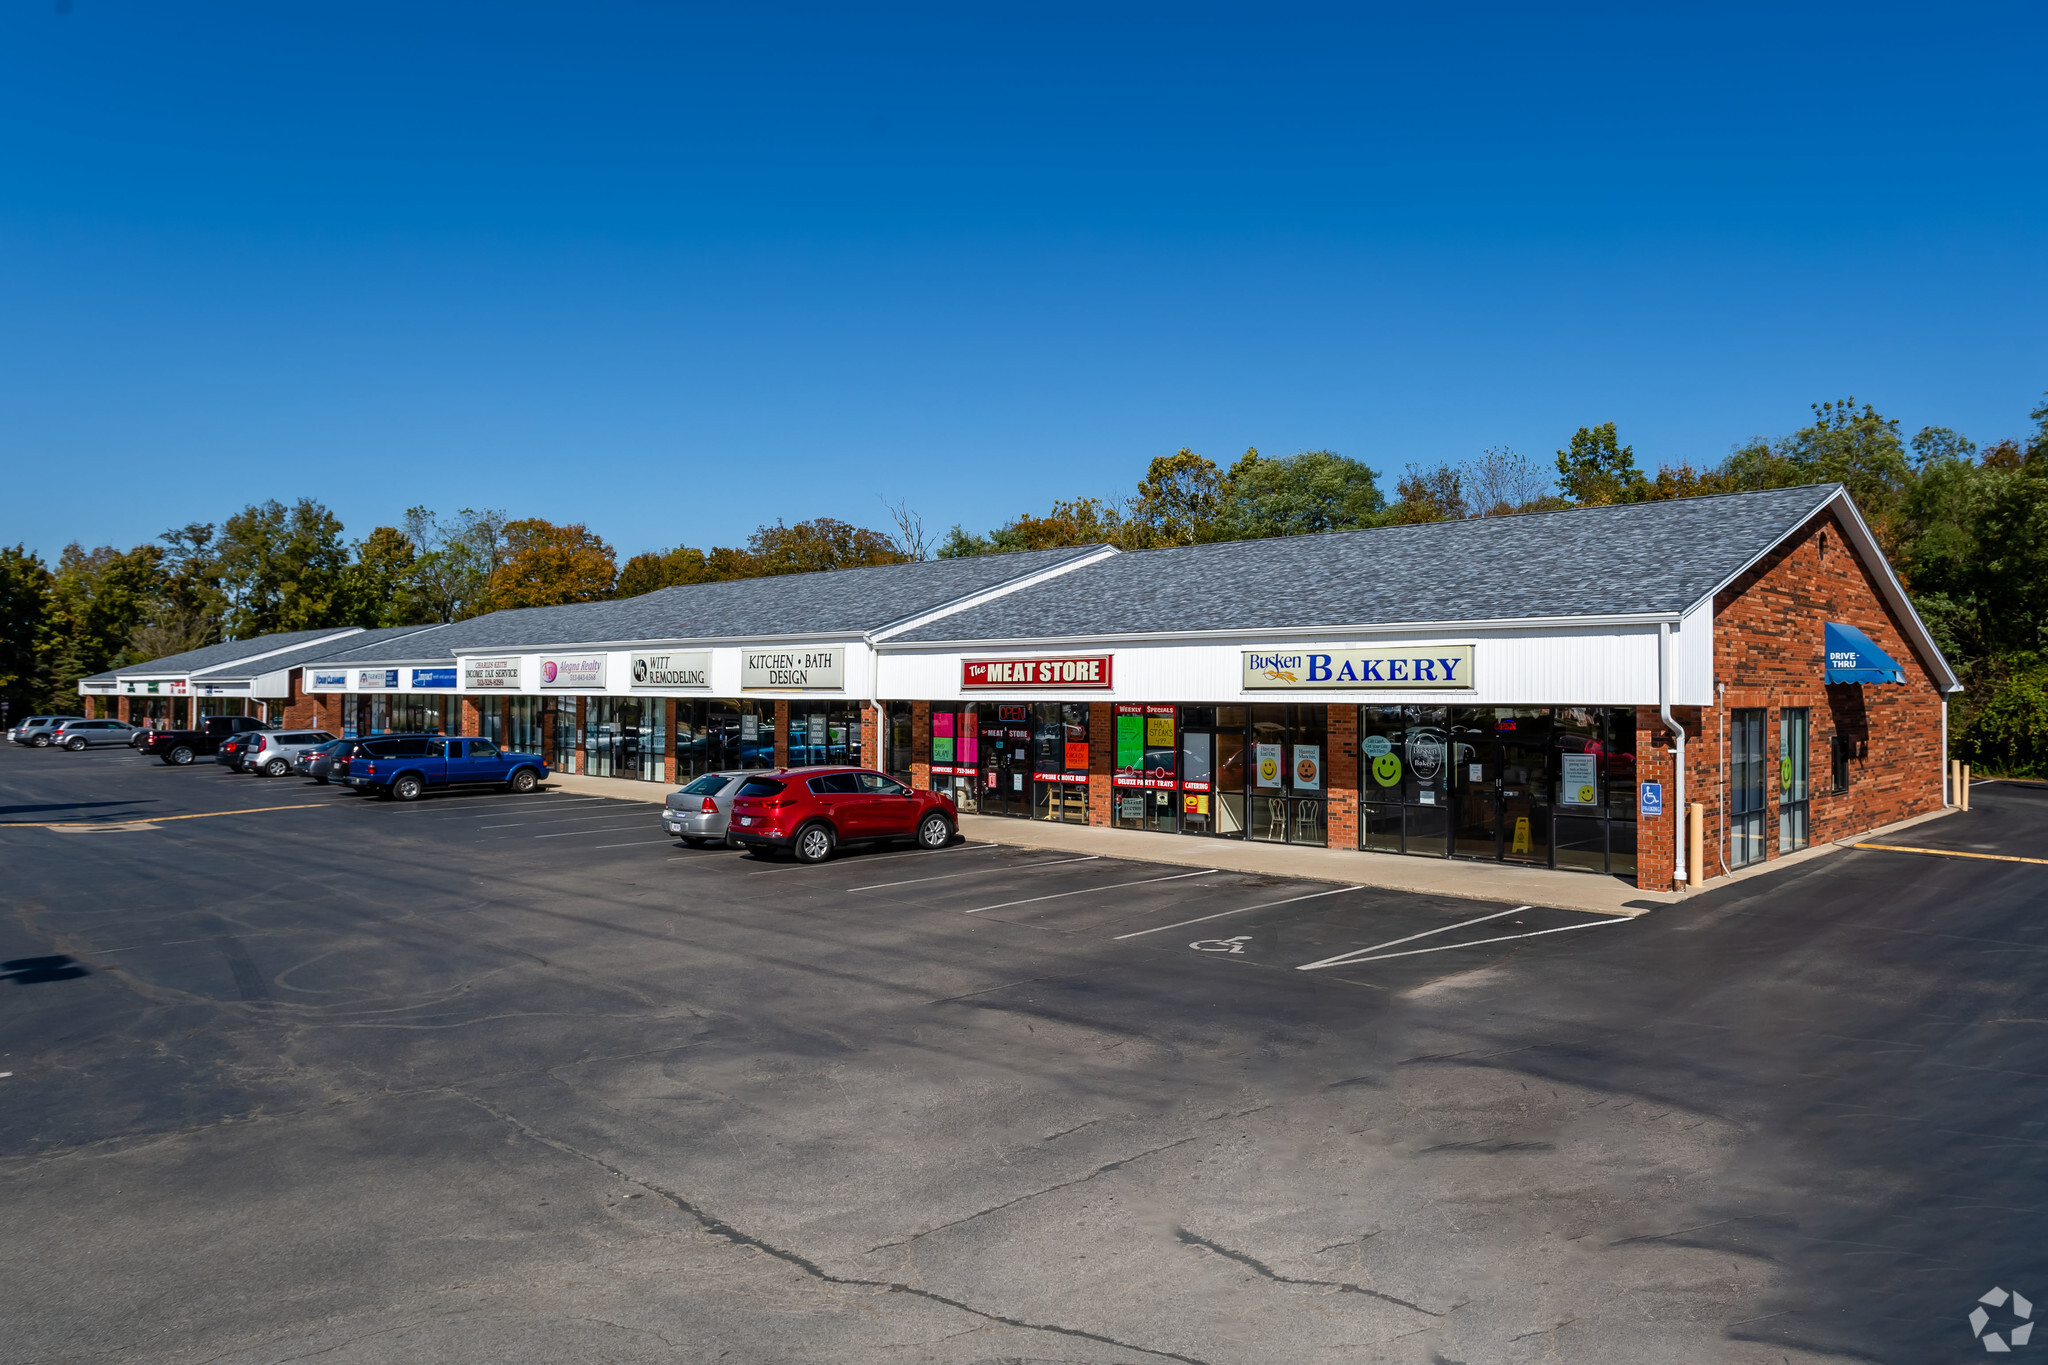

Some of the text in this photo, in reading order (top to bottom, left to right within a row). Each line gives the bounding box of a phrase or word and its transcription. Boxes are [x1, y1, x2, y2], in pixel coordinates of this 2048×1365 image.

[749, 653, 832, 669] KITCHEN BATH
[1830, 652, 1860, 660] DRIVE-
[559, 660, 602, 674] Alegna Realty
[650, 656, 670, 669] WITT
[1250, 653, 1301, 673] Busken
[1832, 660, 1857, 668] THRU
[968, 664, 986, 677] The
[987, 660, 1100, 682] MEAT STORE
[1306, 654, 1462, 682] BAKERY
[466, 669, 483, 678] INCOME
[485, 669, 494, 678] TAX
[495, 669, 518, 677] SERVICE
[650, 670, 704, 684] REMODELING
[769, 670, 808, 685] DESIGN
[999, 706, 1025, 721] OPEN
[1153, 719, 1170, 729] HAM
[1494, 722, 1516, 730] OPEN
[1009, 730, 1028, 738] STORE
[1149, 728, 1174, 737] STEAKS
[1414, 759, 1436, 768] Bakery
[1041, 773, 1057, 781] PRIME
[1117, 778, 1174, 788] DELUXE PARTY TRAYS
[1184, 782, 1209, 790] CATERING
